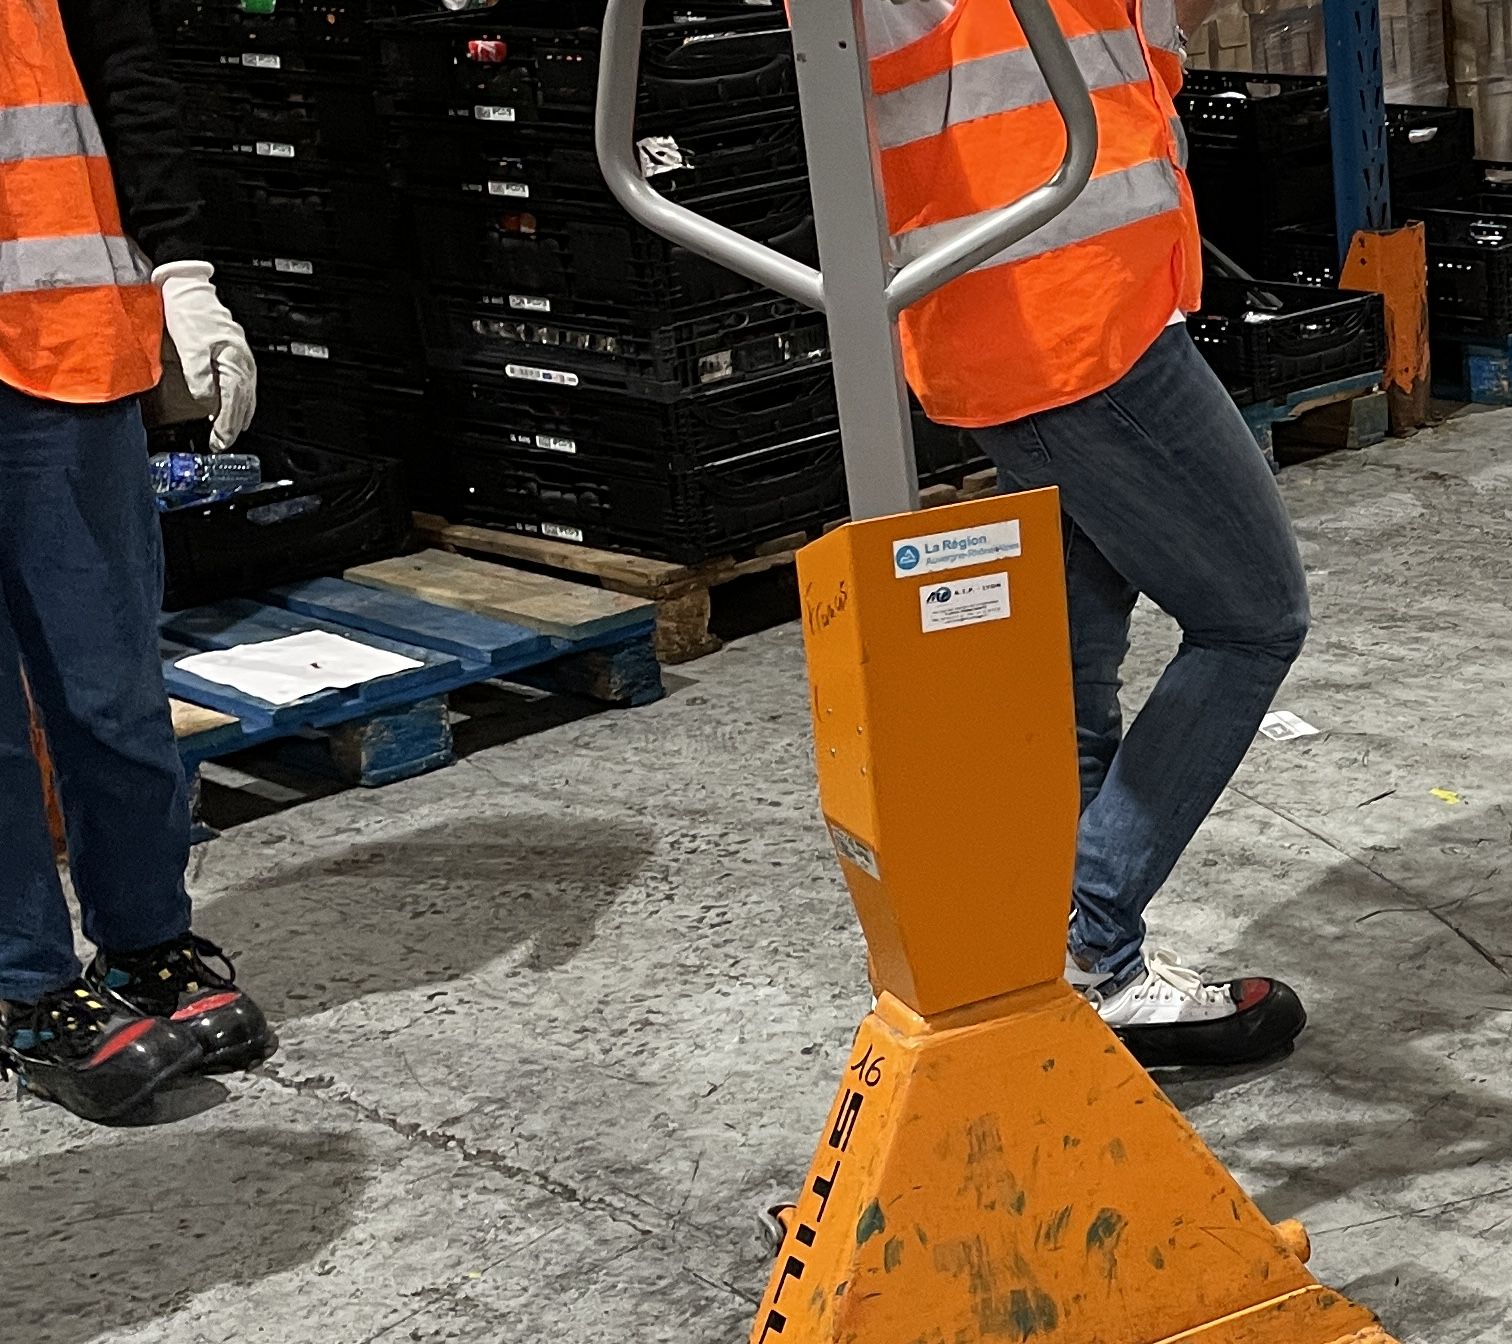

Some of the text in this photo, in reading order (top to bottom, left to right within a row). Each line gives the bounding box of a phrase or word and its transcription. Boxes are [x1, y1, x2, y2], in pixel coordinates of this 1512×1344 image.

[924, 535, 987, 554] La Région
[850, 1043, 886, 1087] 16
